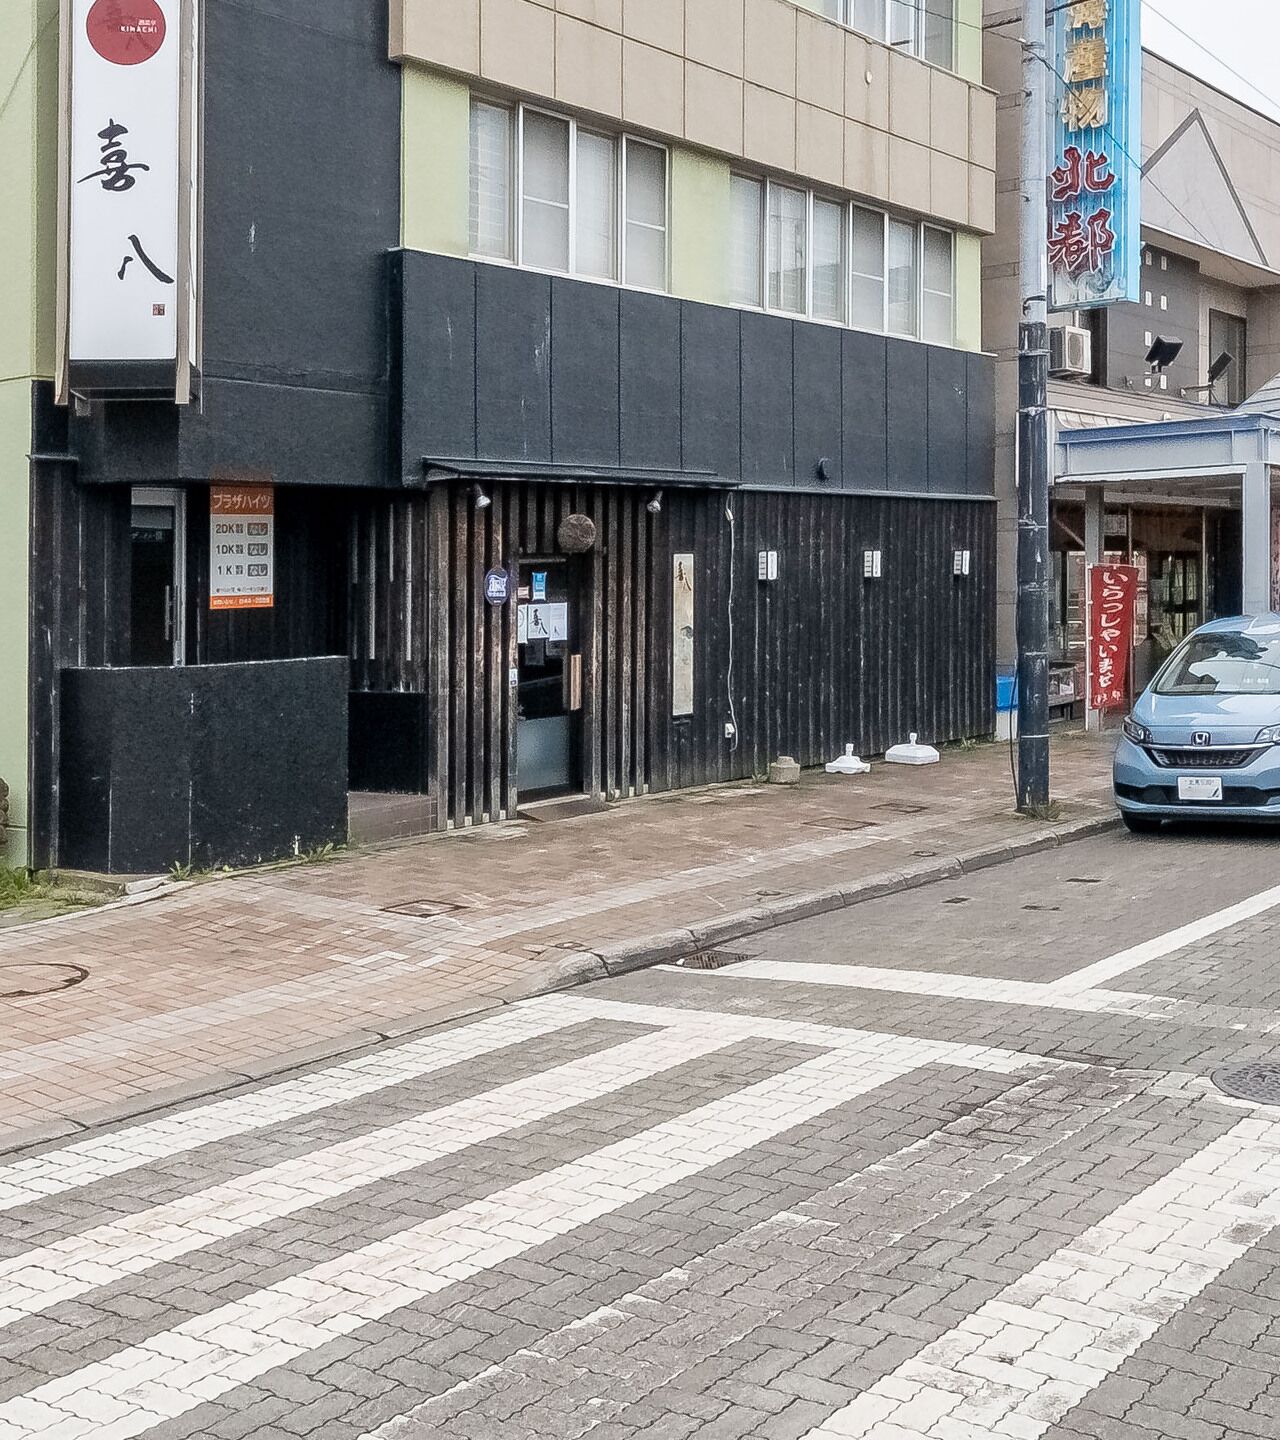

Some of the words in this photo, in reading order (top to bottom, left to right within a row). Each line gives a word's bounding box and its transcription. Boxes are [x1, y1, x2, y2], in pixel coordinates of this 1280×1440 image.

[77, 118, 175, 285] 喜八
[1048, 145, 1116, 273] 北都
[213, 494, 271, 509] プラザハイツ
[216, 524, 234, 534] 2DK
[216, 545, 234, 555] 1DK
[248, 544, 267, 556] なし
[248, 564, 267, 576] なし
[1098, 572, 1129, 688] いらっしゃいませ
